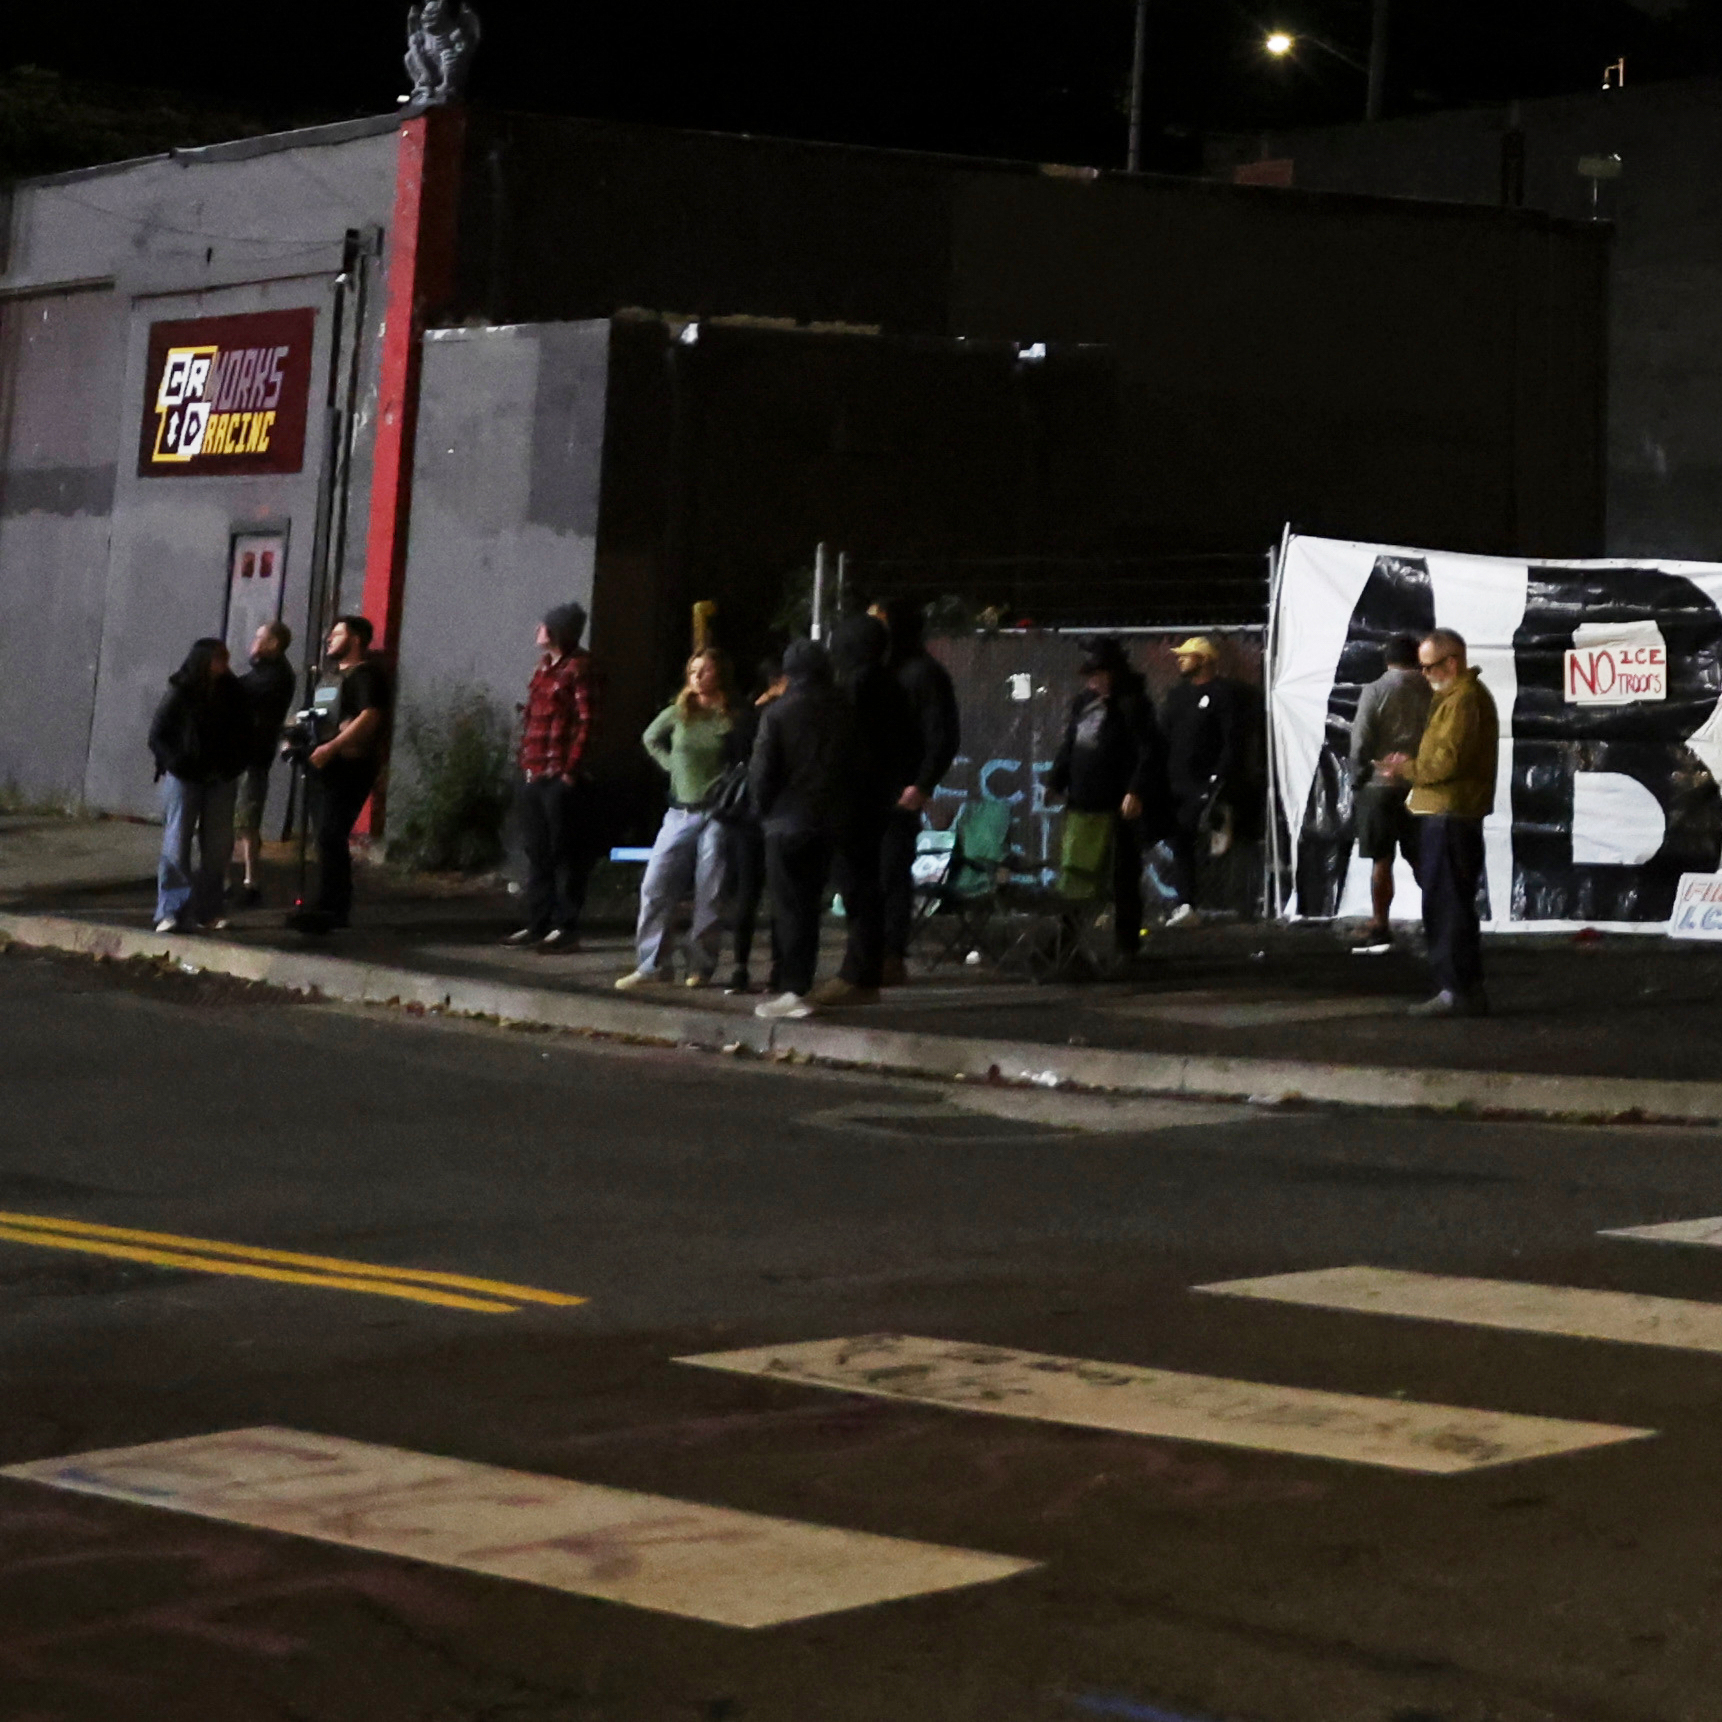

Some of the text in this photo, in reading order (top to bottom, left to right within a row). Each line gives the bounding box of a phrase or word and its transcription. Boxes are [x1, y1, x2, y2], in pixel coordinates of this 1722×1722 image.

[200, 410, 277, 455] RACING
[1570, 649, 1616, 696] NO
[1620, 648, 1666, 665] ICE
[1617, 673, 1662, 694] TROOPS
